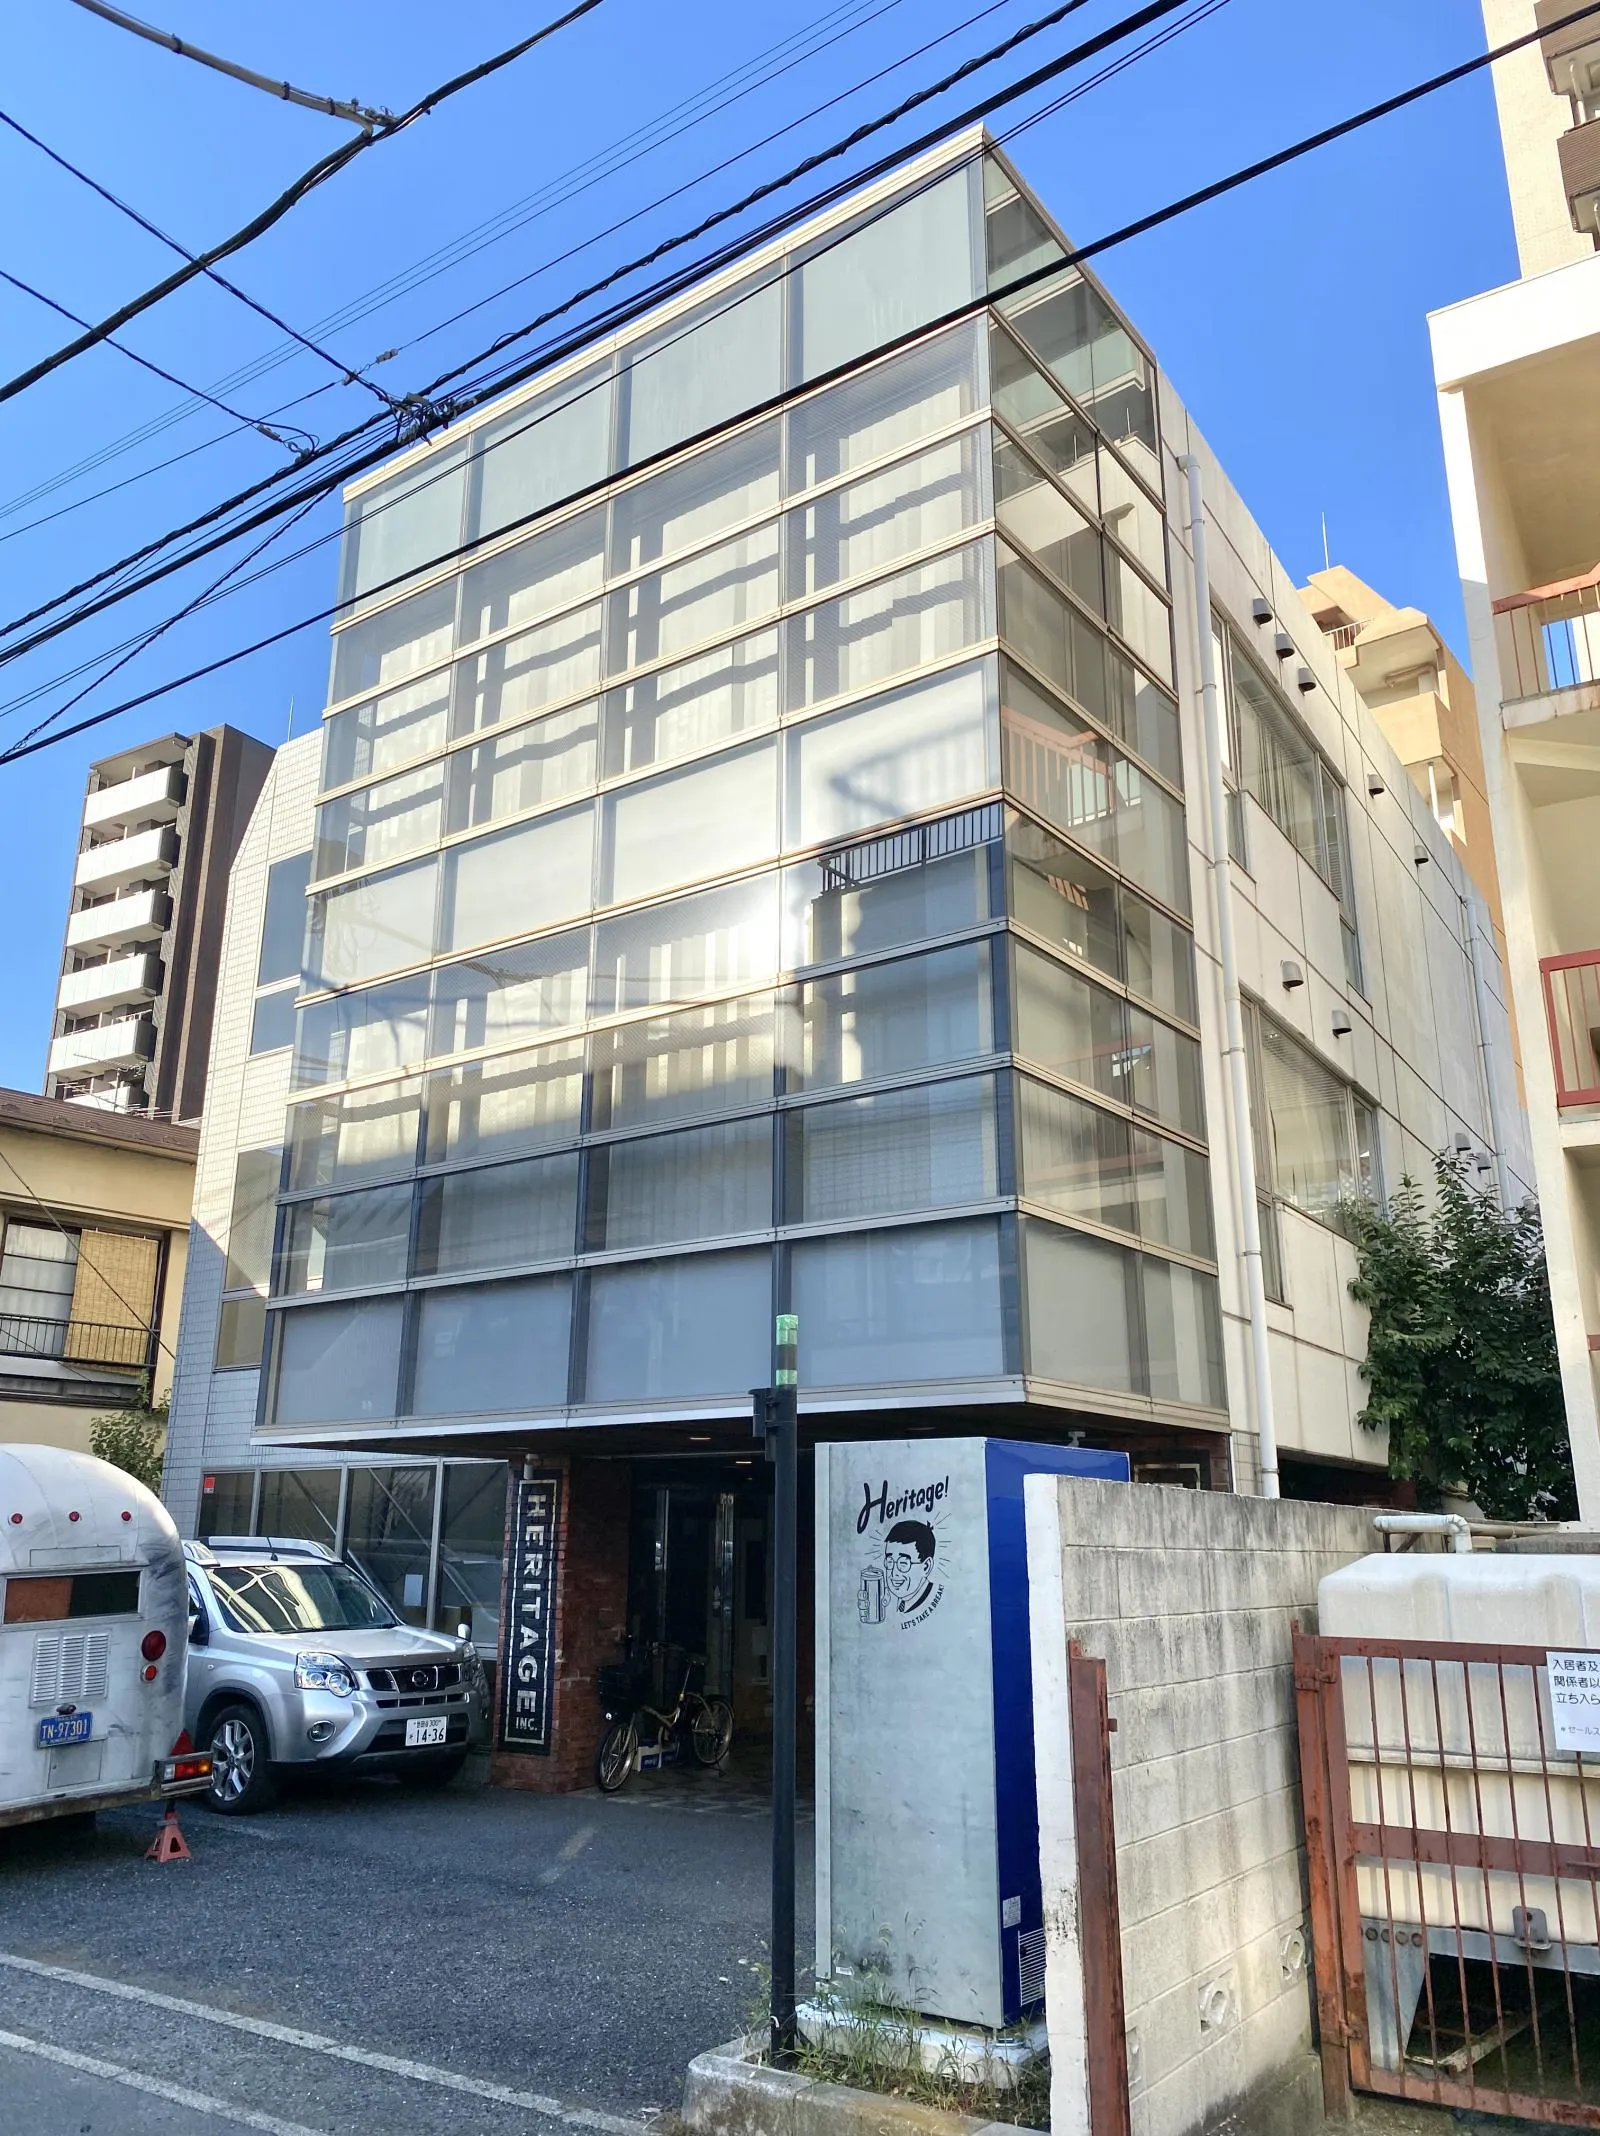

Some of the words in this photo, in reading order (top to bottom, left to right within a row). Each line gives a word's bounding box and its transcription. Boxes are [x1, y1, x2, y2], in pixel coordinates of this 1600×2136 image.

[857, 1475, 949, 1534] Heritage!
[516, 1494, 546, 1712] HERITAGE
[901, 1620, 916, 1630] LET'S
[915, 1609, 930, 1624] TAKE
[1553, 1659, 1600, 1672] 入居者及
[1556, 1692, 1600, 1705] 立ち入ら
[42, 1719, 88, 1740] TN-97301
[515, 1717, 538, 1731] INC.
[416, 1727, 444, 1743] 14-36
